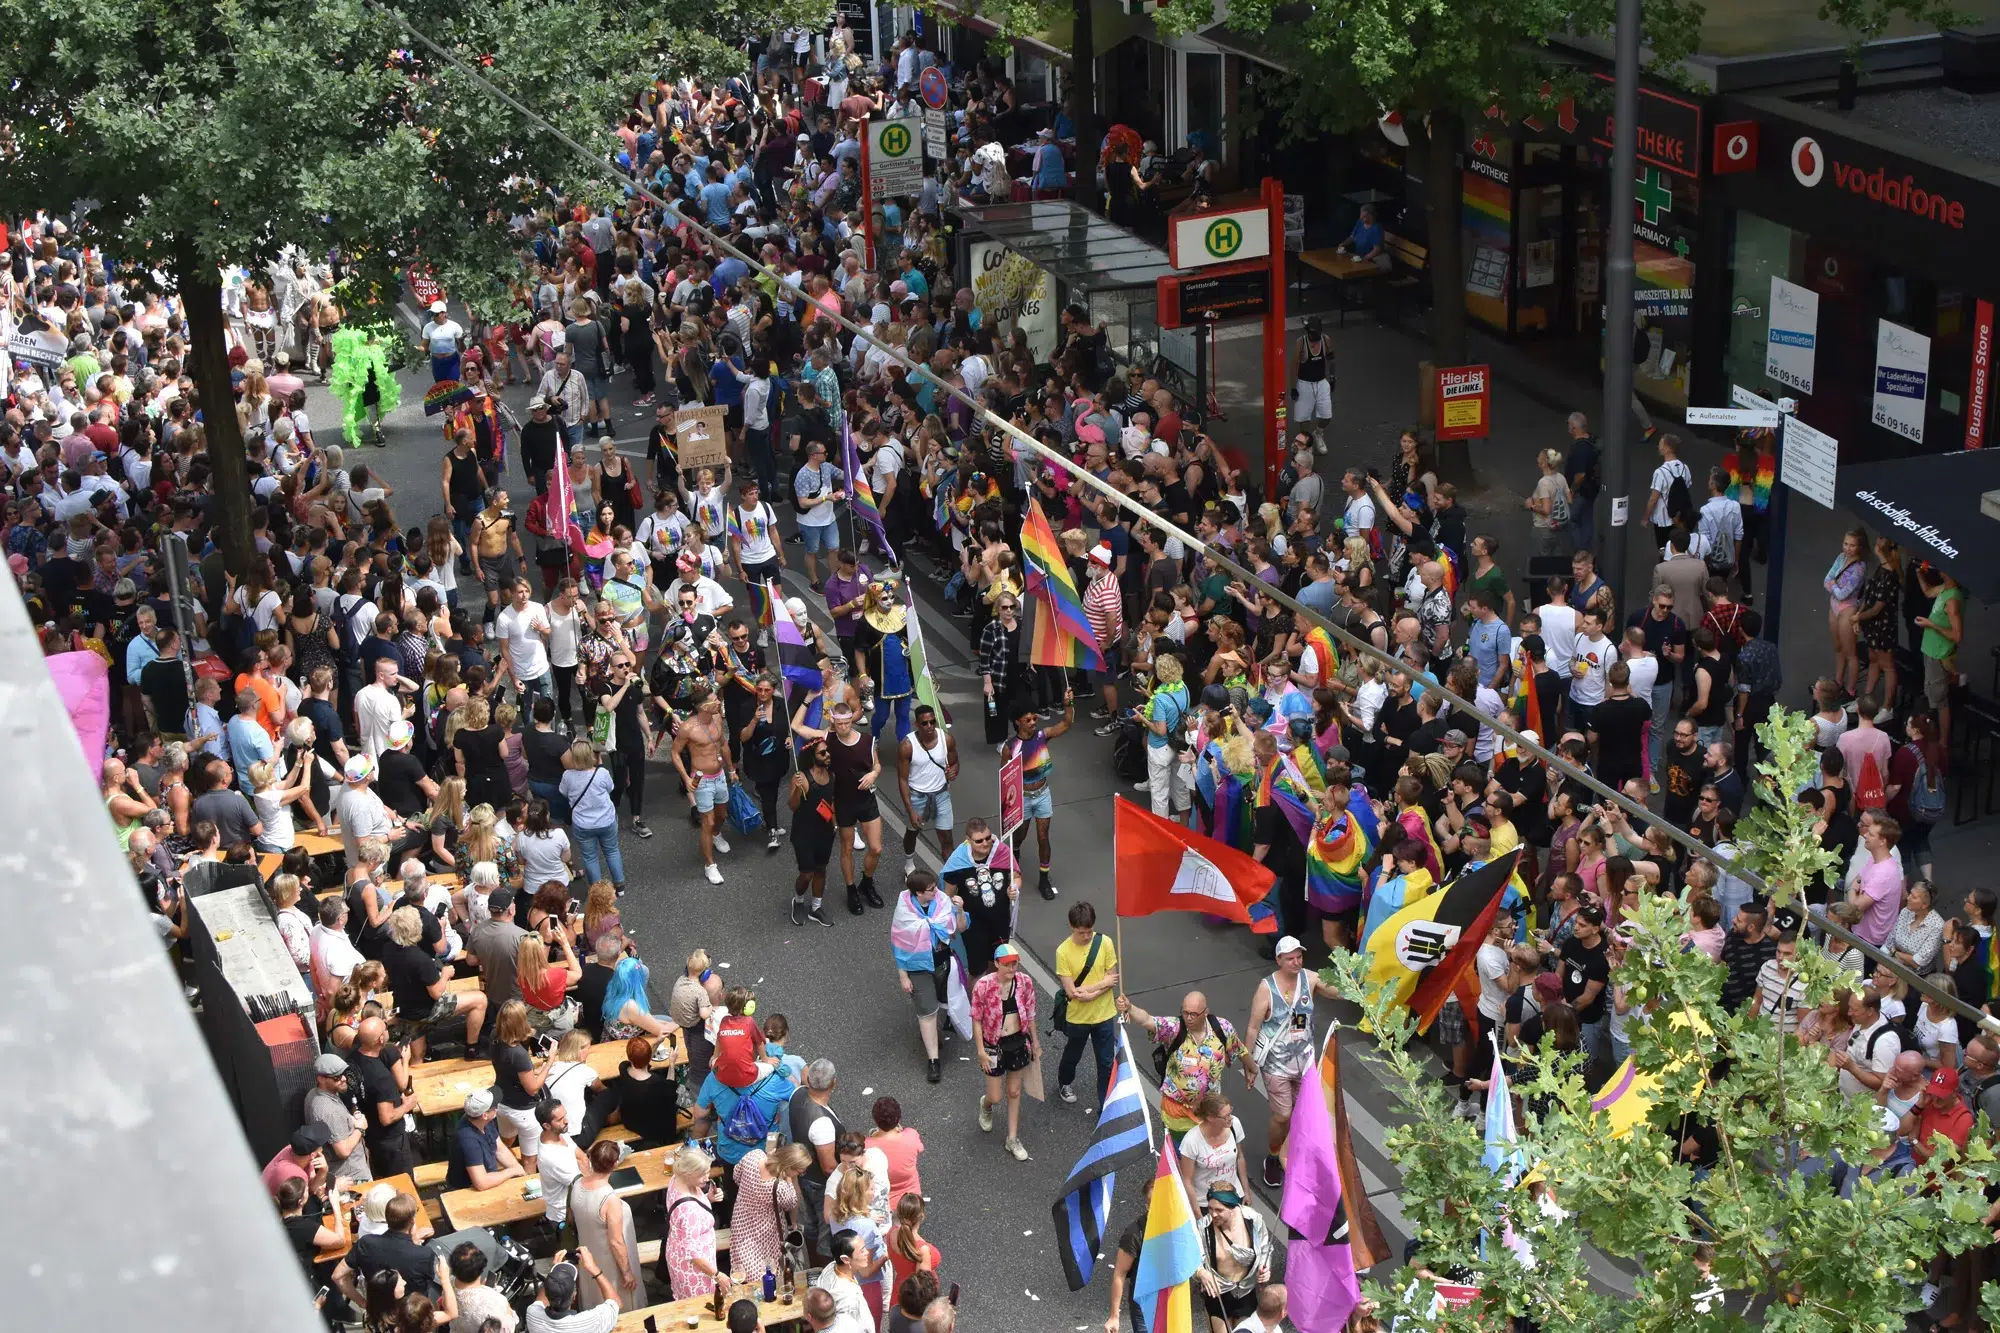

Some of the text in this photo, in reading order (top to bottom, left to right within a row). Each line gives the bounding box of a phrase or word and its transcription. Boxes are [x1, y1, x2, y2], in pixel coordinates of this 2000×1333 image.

[1606, 116, 1684, 163] ATHEKE
[880, 160, 914, 168] Gurlittstraße
[1471, 160, 1508, 183] APOTHEKE
[1832, 160, 1965, 229] vodafone
[1186, 281, 1218, 290] Gurlittstraße
[1671, 289, 1679, 300] AB
[1680, 288, 1692, 299] JULI
[994, 300, 1040, 322] COKIES
[1678, 304, 1688, 315] Uhr
[1772, 331, 1813, 346] Zu vermieten
[1441, 371, 1484, 385] Hier ist
[1769, 365, 1810, 391] 46 09 16 46
[1878, 370, 1925, 384] Ihr Ladenflächen-
[1970, 324, 1988, 437] Business Store
[1446, 387, 1457, 395] DIE
[1886, 382, 1915, 393] Spezialist!
[1700, 412, 1737, 420] Außenalster
[1875, 412, 1921, 440] 46 09 16 46
[1856, 491, 1959, 559] ein schattiges fritzchen.
[1781, 916, 1794, 928] 3
